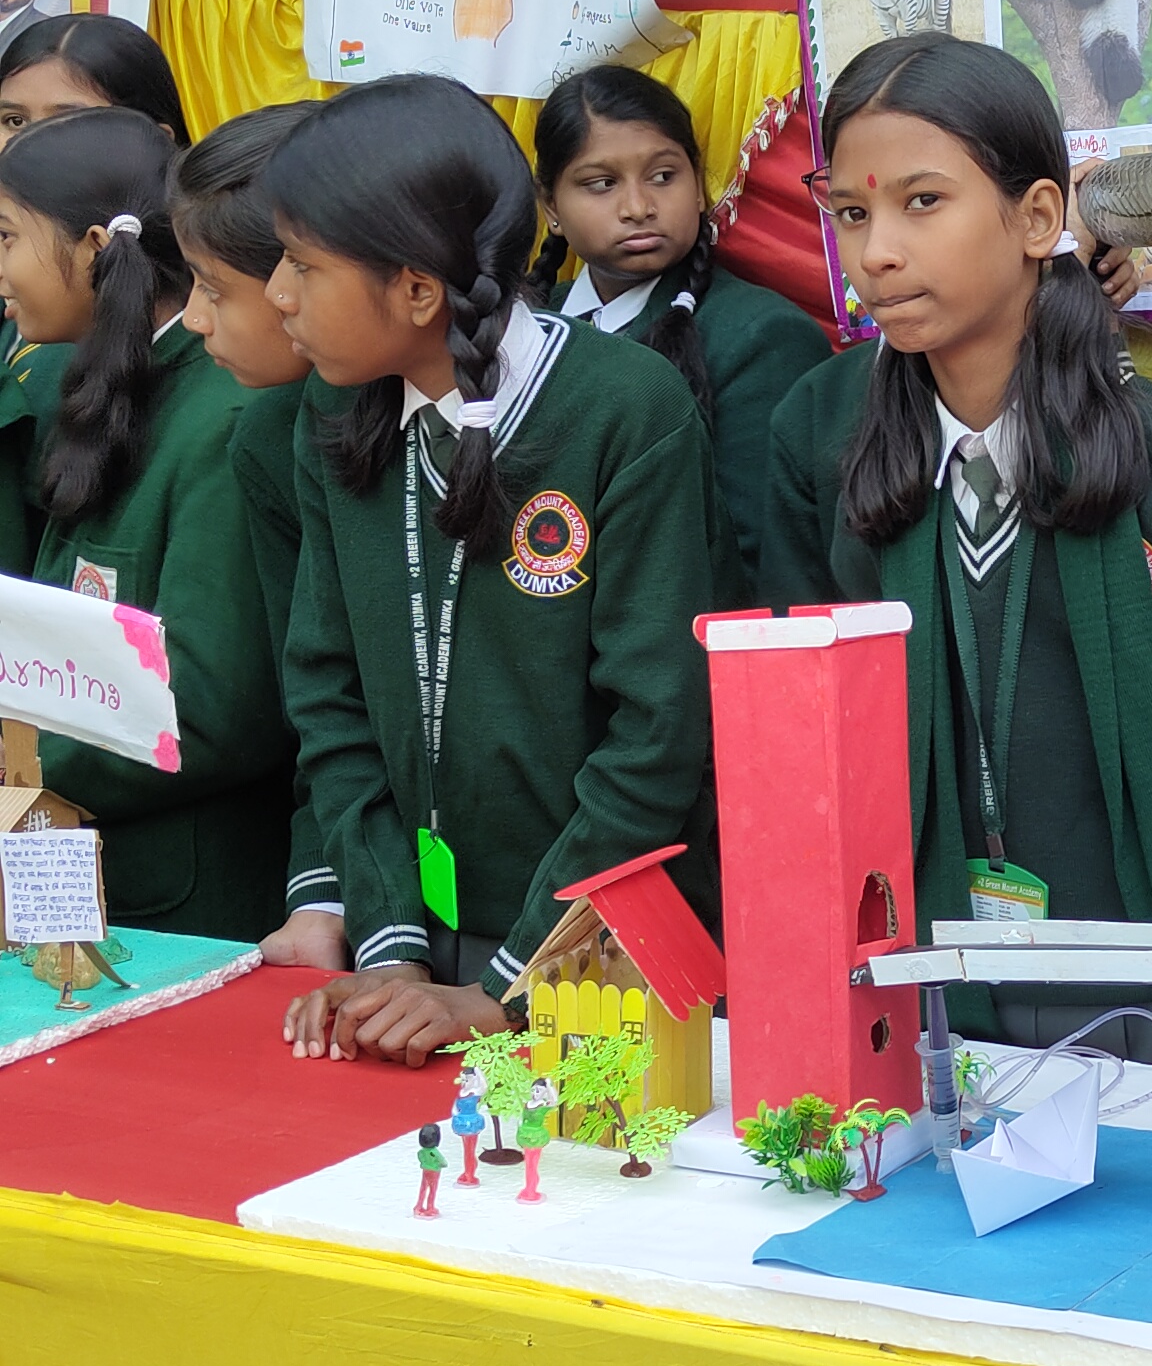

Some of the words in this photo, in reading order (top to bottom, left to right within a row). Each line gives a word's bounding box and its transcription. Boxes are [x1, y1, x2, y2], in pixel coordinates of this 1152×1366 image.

[406, 443, 417, 492] ACADEMY,
[405, 493, 417, 528] MOUNT
[515, 505, 535, 541] GREEN
[534, 495, 564, 510] MOUNT
[561, 503, 586, 554] ACADEMY
[406, 532, 420, 564] GREEN
[451, 538, 466, 573] GREEN
[510, 563, 578, 594] DUMKA
[411, 591, 426, 628] DUMKA
[440, 599, 454, 634] DUMKA
[414, 630, 430, 678] ACADEMY,
[436, 635, 453, 682] ACADEMY,
[434, 682, 447, 717] MOUNT
[985, 879, 1001, 891] Green
[1018, 884, 1042, 901] Academy
